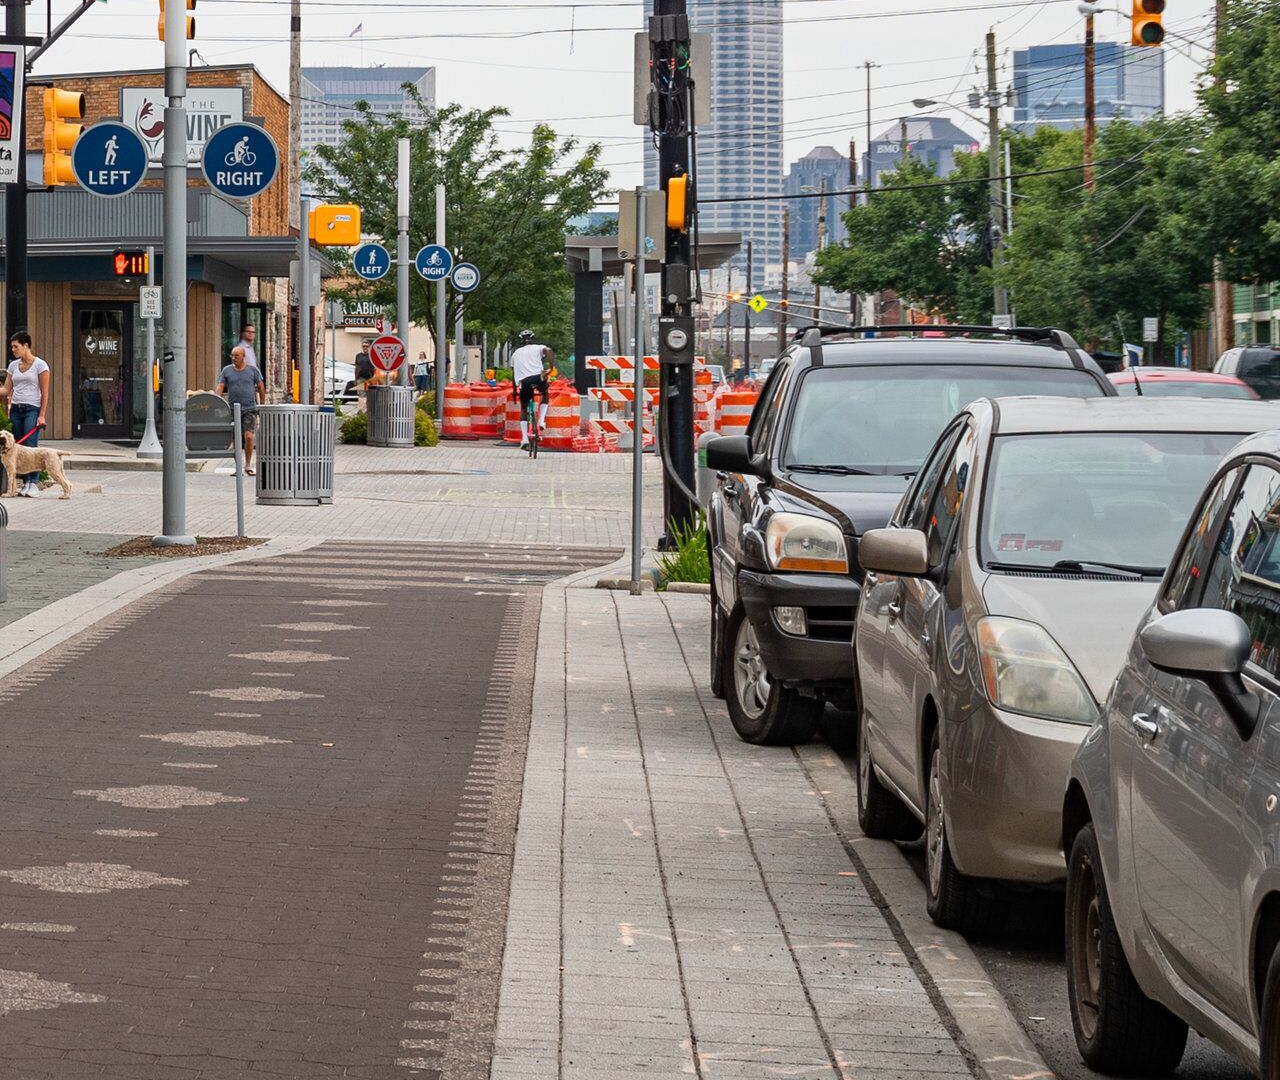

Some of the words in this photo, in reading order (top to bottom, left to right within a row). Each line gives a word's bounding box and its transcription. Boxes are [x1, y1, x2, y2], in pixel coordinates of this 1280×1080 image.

[191, 101, 215, 109] THE
[877, 144, 900, 154] BMO
[88, 170, 131, 186] LEFT
[216, 171, 263, 187] RIGHT
[361, 266, 382, 274] LEFT
[422, 267, 446, 275] RIGHT
[344, 317, 364, 325] CHECK
[98, 340, 118, 351] WINE
